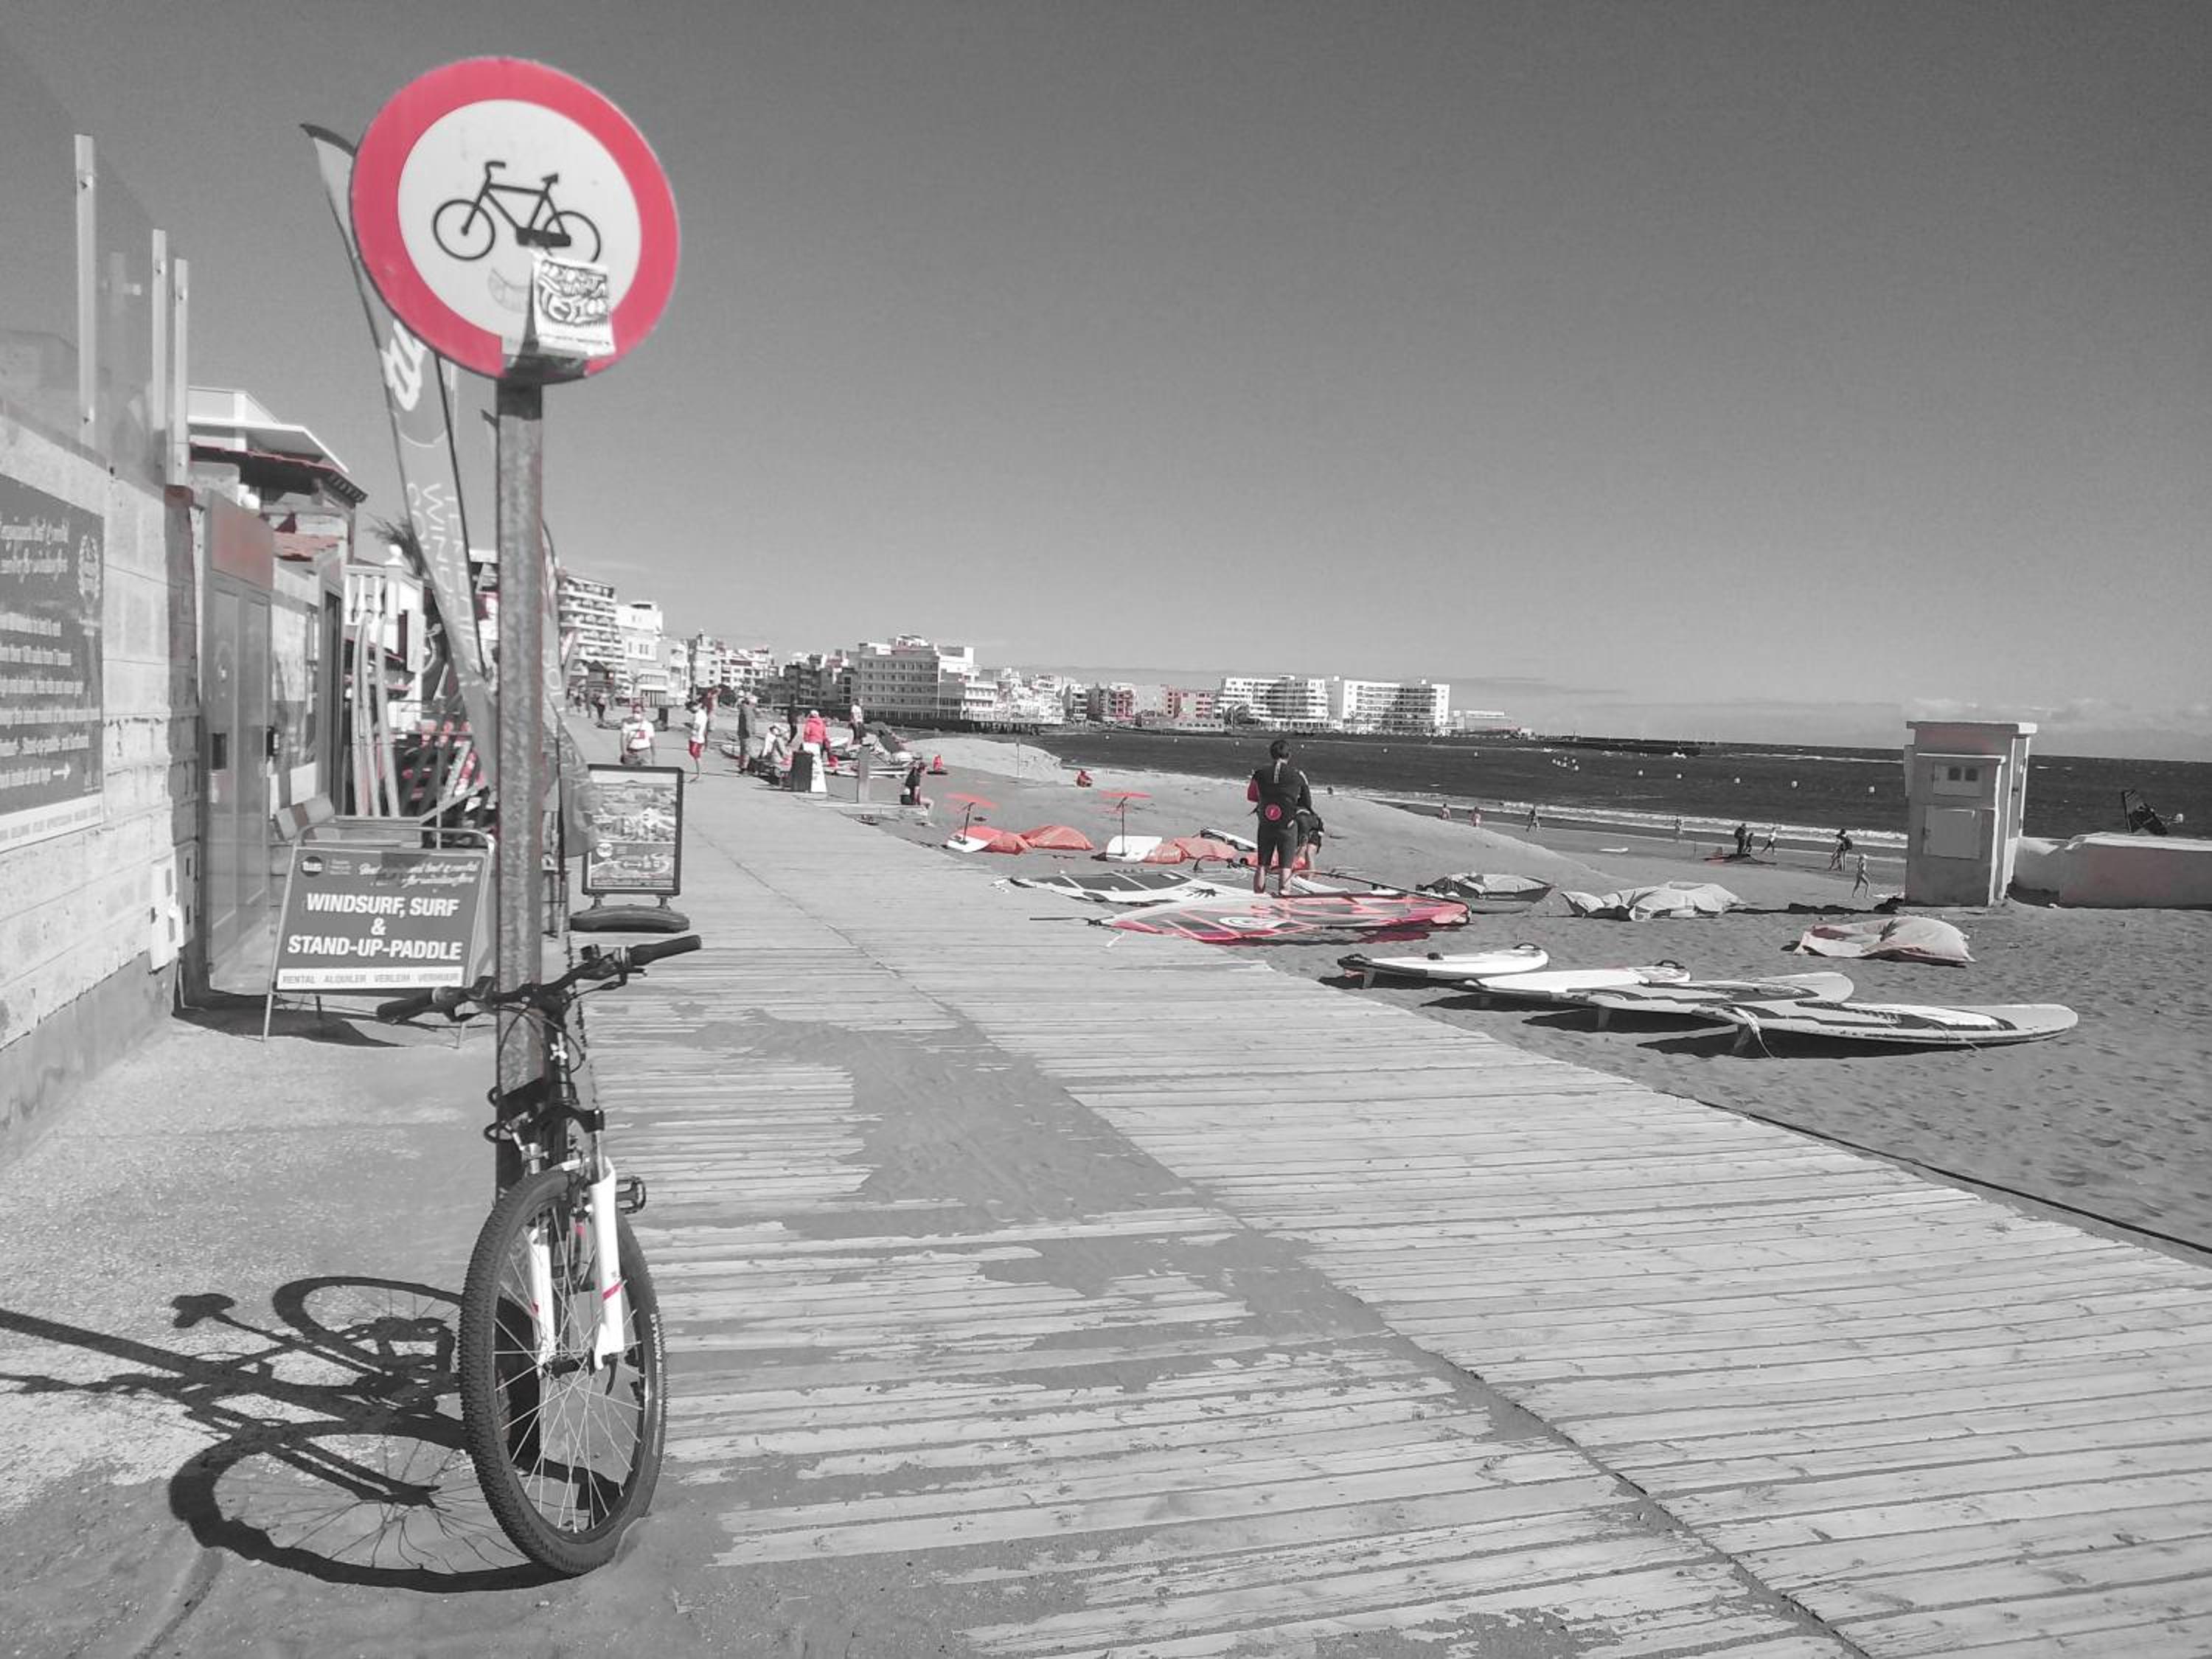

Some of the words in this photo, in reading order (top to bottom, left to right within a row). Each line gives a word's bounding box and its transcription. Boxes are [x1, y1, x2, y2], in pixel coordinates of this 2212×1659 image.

[307, 892, 406, 919] WINDSURF,
[409, 897, 461, 917] SURF
[370, 917, 387, 936] &
[287, 935, 464, 960] STAND-UP-PADDLE
